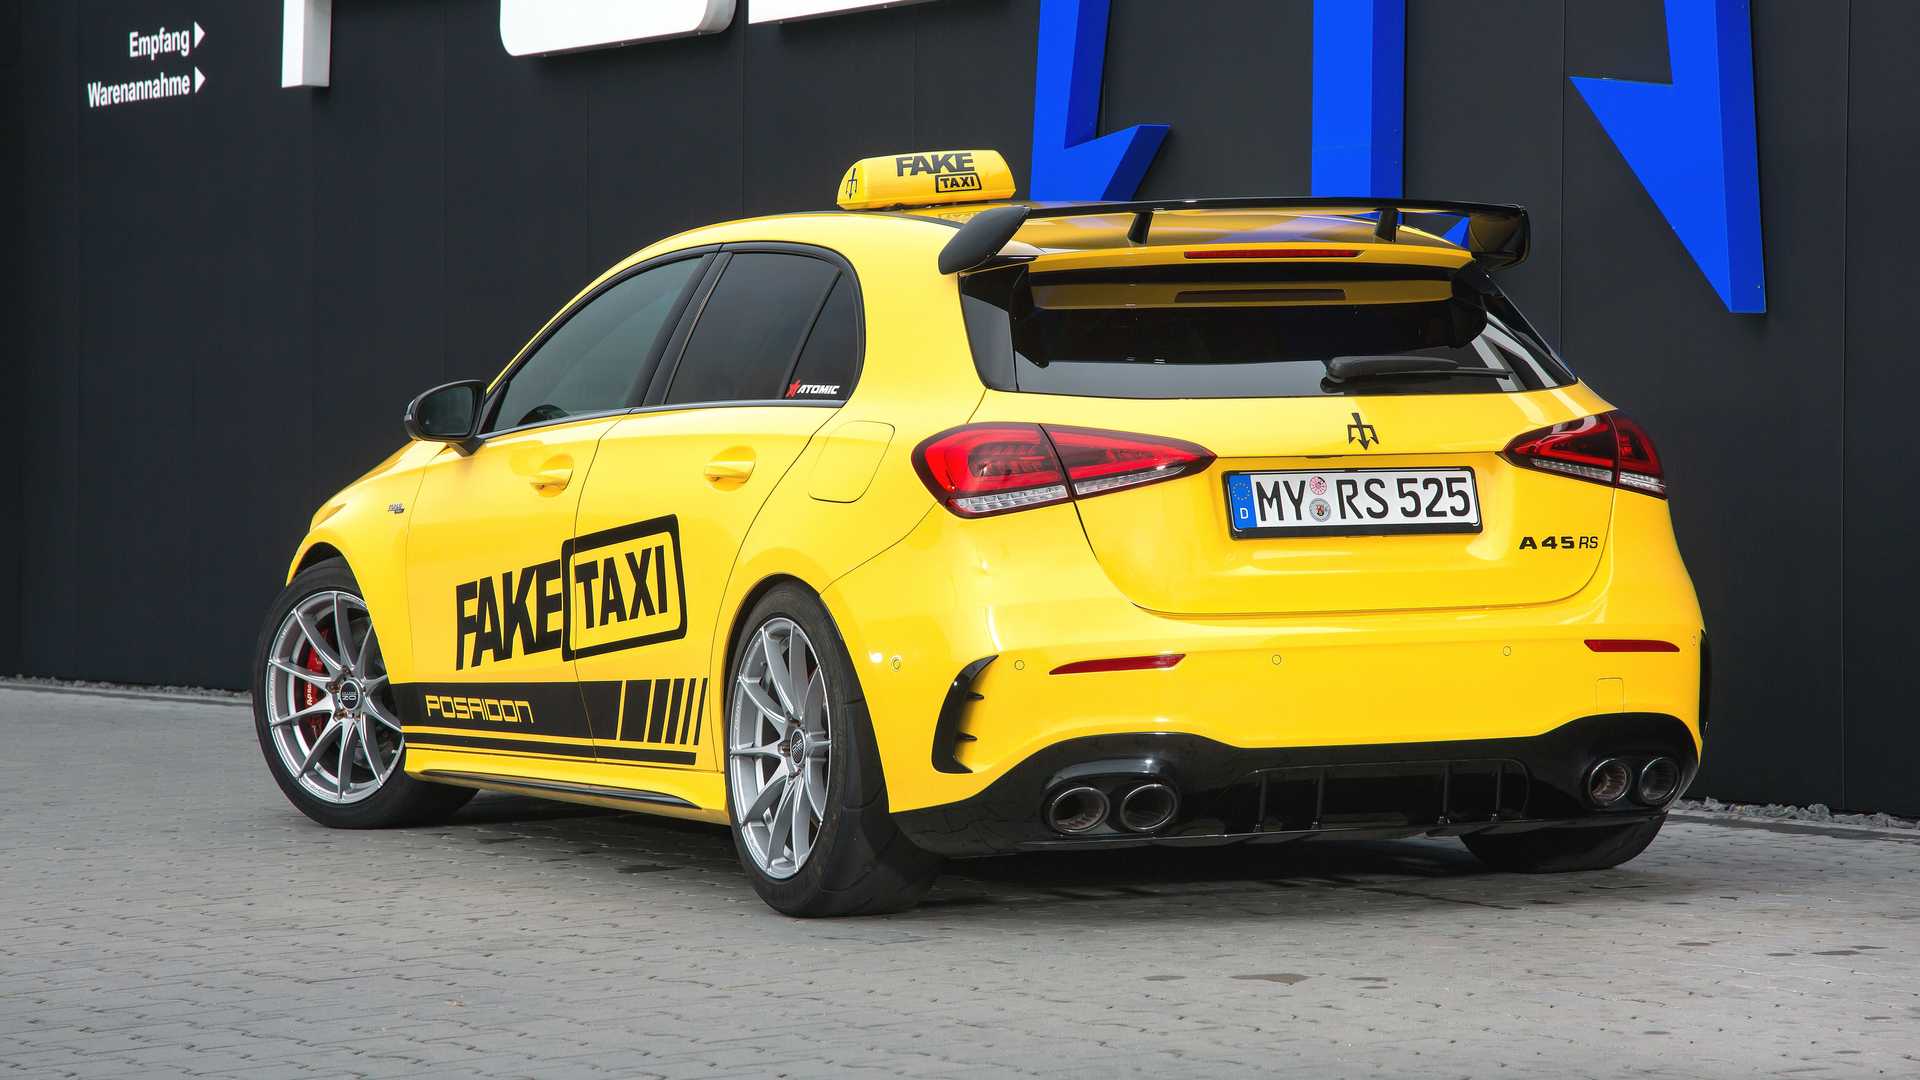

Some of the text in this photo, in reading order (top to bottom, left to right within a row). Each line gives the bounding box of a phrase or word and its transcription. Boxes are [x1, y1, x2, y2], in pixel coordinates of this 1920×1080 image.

[129, 27, 190, 60] Empfang
[87, 72, 191, 107] Warenannahme
[896, 152, 975, 177] FAKE
[940, 176, 975, 189] TAXI
[798, 384, 840, 395] ATOMIC
[1256, 480, 1306, 521] MY
[1336, 478, 1389, 519] RS
[1396, 477, 1471, 518] 525
[1240, 508, 1248, 519] D
[1578, 536, 1598, 549] RS
[456, 545, 668, 671] FAKE TAXI
